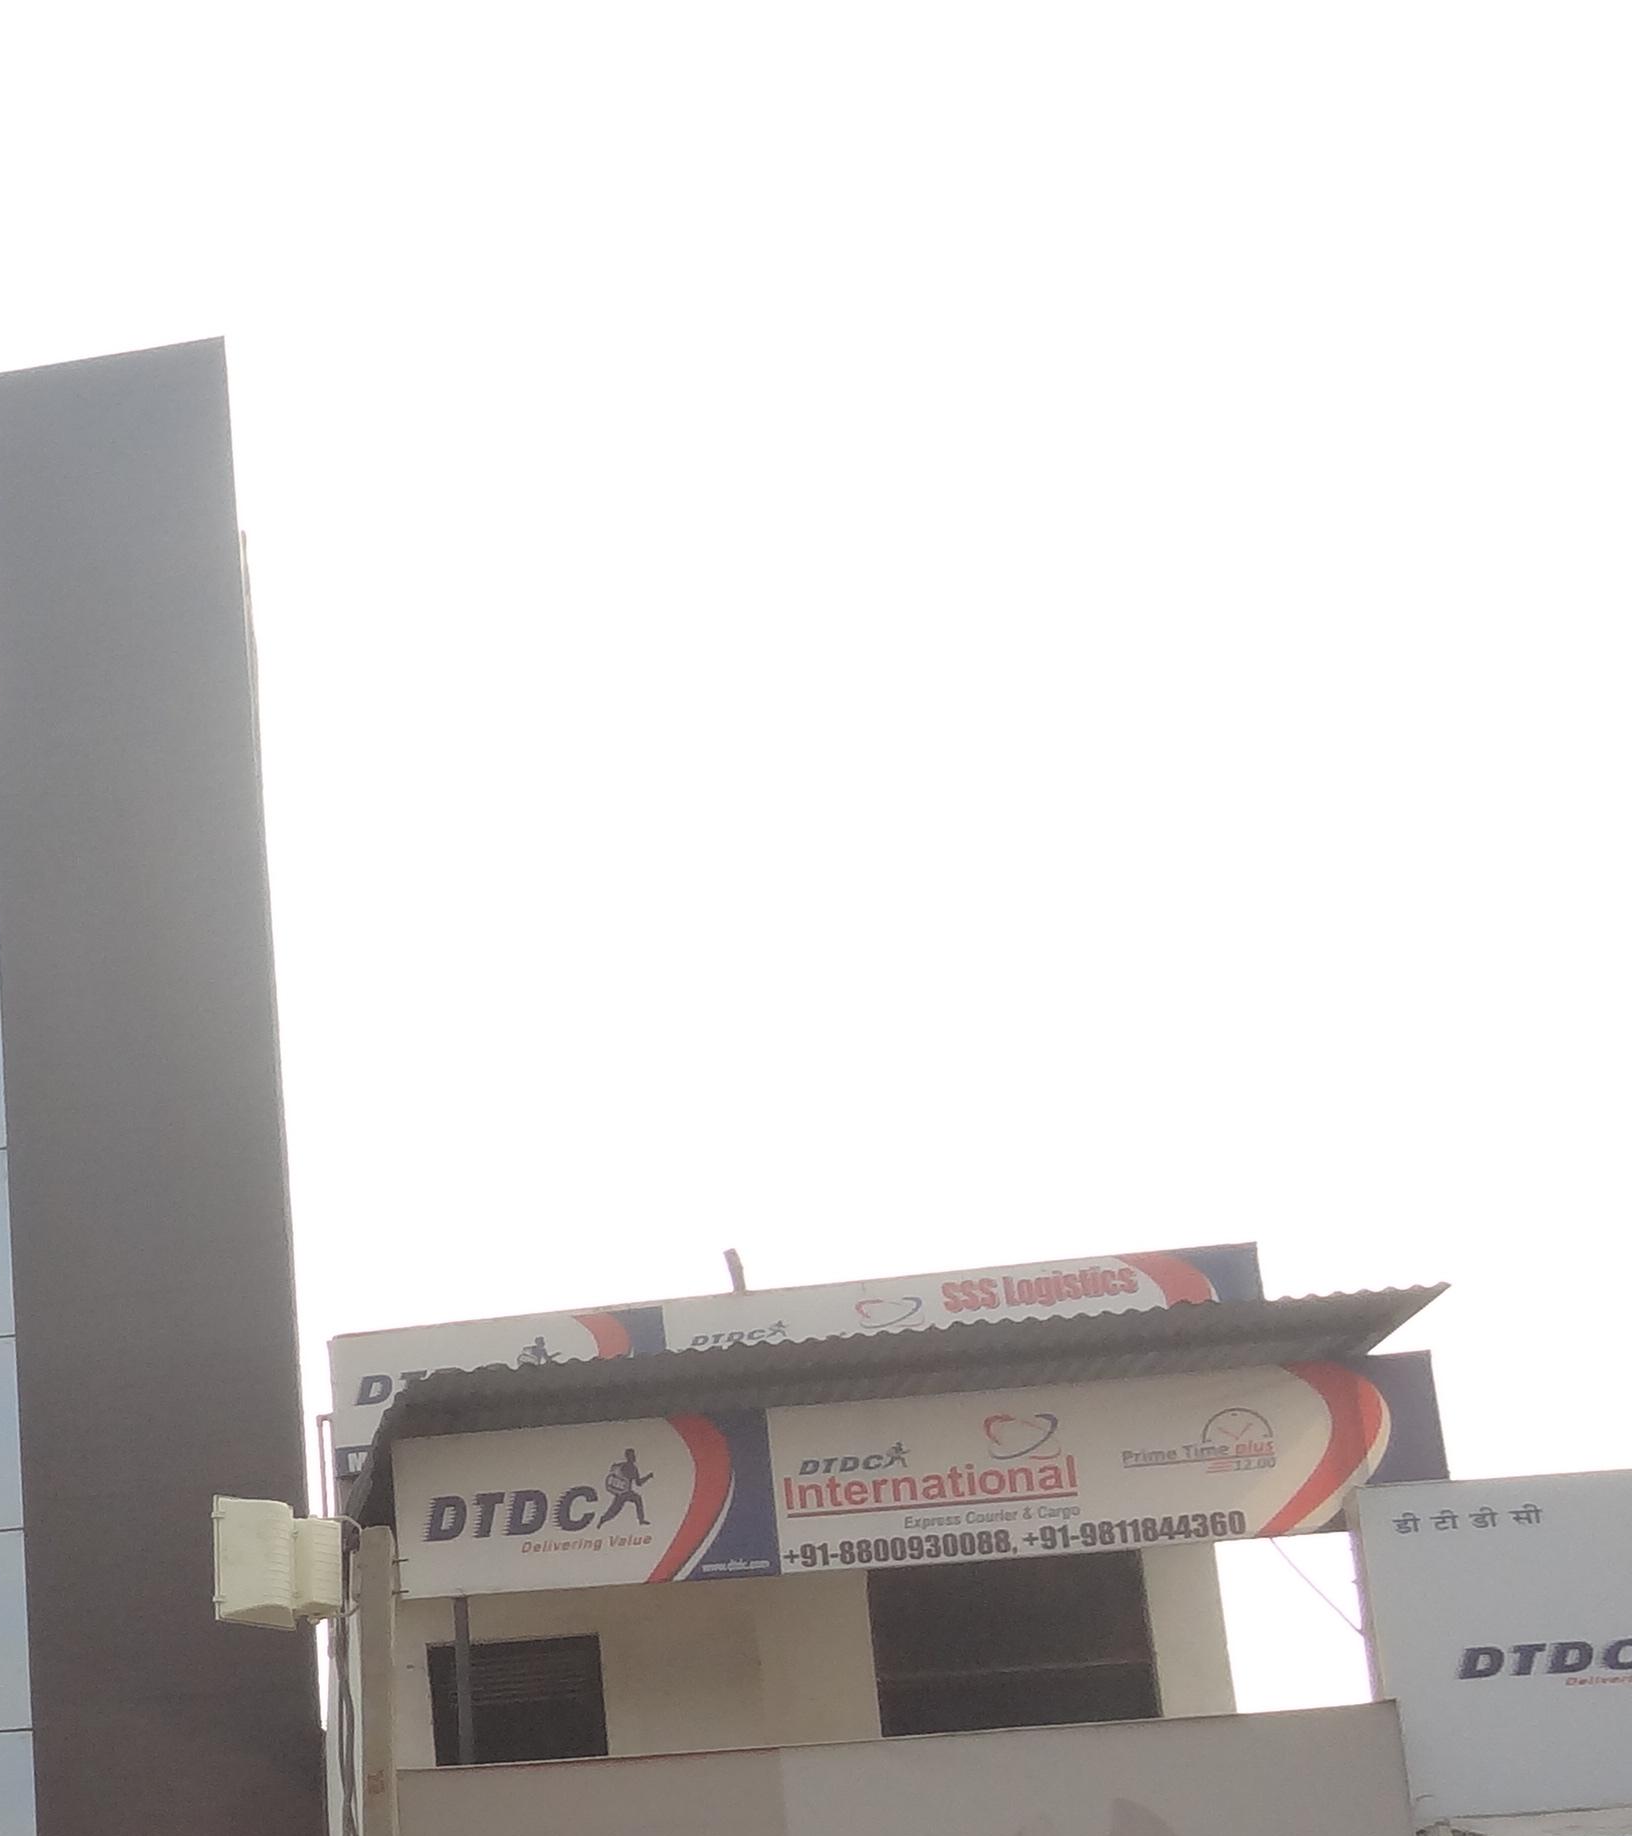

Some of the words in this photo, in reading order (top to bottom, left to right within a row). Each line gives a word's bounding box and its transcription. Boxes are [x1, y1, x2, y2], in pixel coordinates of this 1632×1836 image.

[942, 1279, 998, 1313] SSS
[1002, 1266, 1139, 1308] Logistics
[354, 1369, 428, 1406] DT
[799, 1454, 887, 1476] DTDC
[1122, 1448, 1177, 1464] Prime
[1182, 1443, 1229, 1459] Time
[1235, 1439, 1274, 1457] plus
[783, 1454, 1079, 1511] International
[422, 1485, 600, 1542] DTDC
[903, 1512, 962, 1531] Express
[966, 1508, 1019, 1526] Courier
[1022, 1506, 1033, 1520] &
[1037, 1504, 1081, 1522] Cargo
[521, 1536, 603, 1555] Delivering
[608, 1534, 653, 1549] Value
[1455, 1638, 1632, 1680] DTDC
